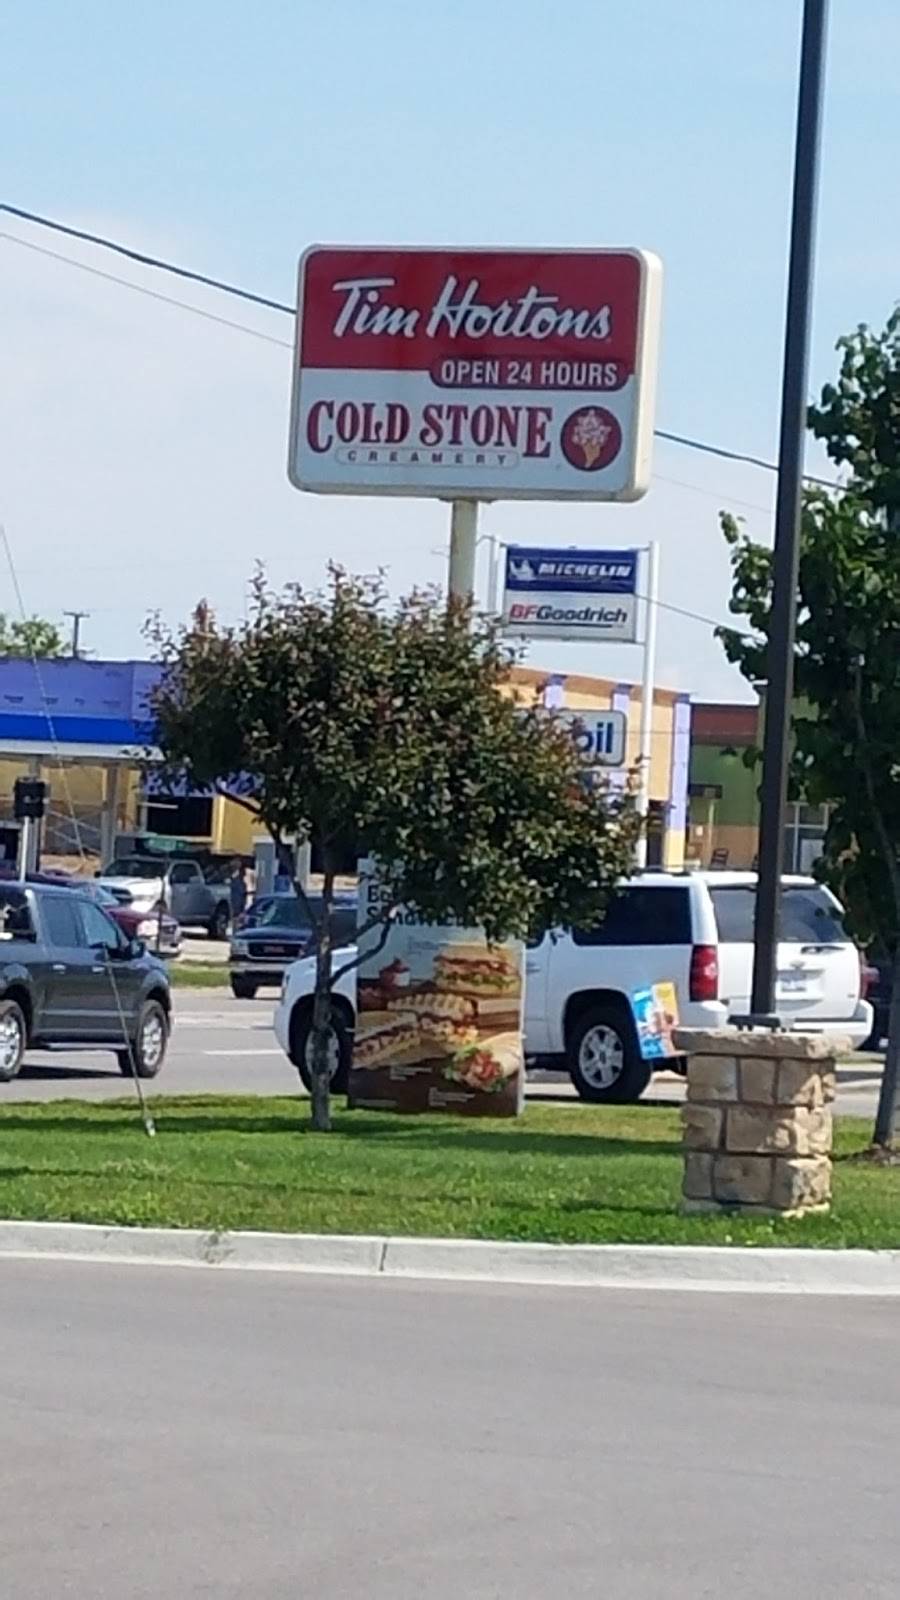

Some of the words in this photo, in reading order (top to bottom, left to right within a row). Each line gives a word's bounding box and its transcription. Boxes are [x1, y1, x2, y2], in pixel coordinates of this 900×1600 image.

[332, 277, 420, 338] Tim
[426, 275, 611, 340] Hortons
[440, 359, 499, 384] OPEN
[507, 361, 532, 385] 24
[540, 361, 618, 387] HOURS
[306, 400, 410, 454] COLD
[419, 404, 553, 458] STONE
[347, 450, 506, 466] CREAMERY
[538, 562, 632, 577] MICHELIN
[509, 604, 628, 623] BFGoodrich
